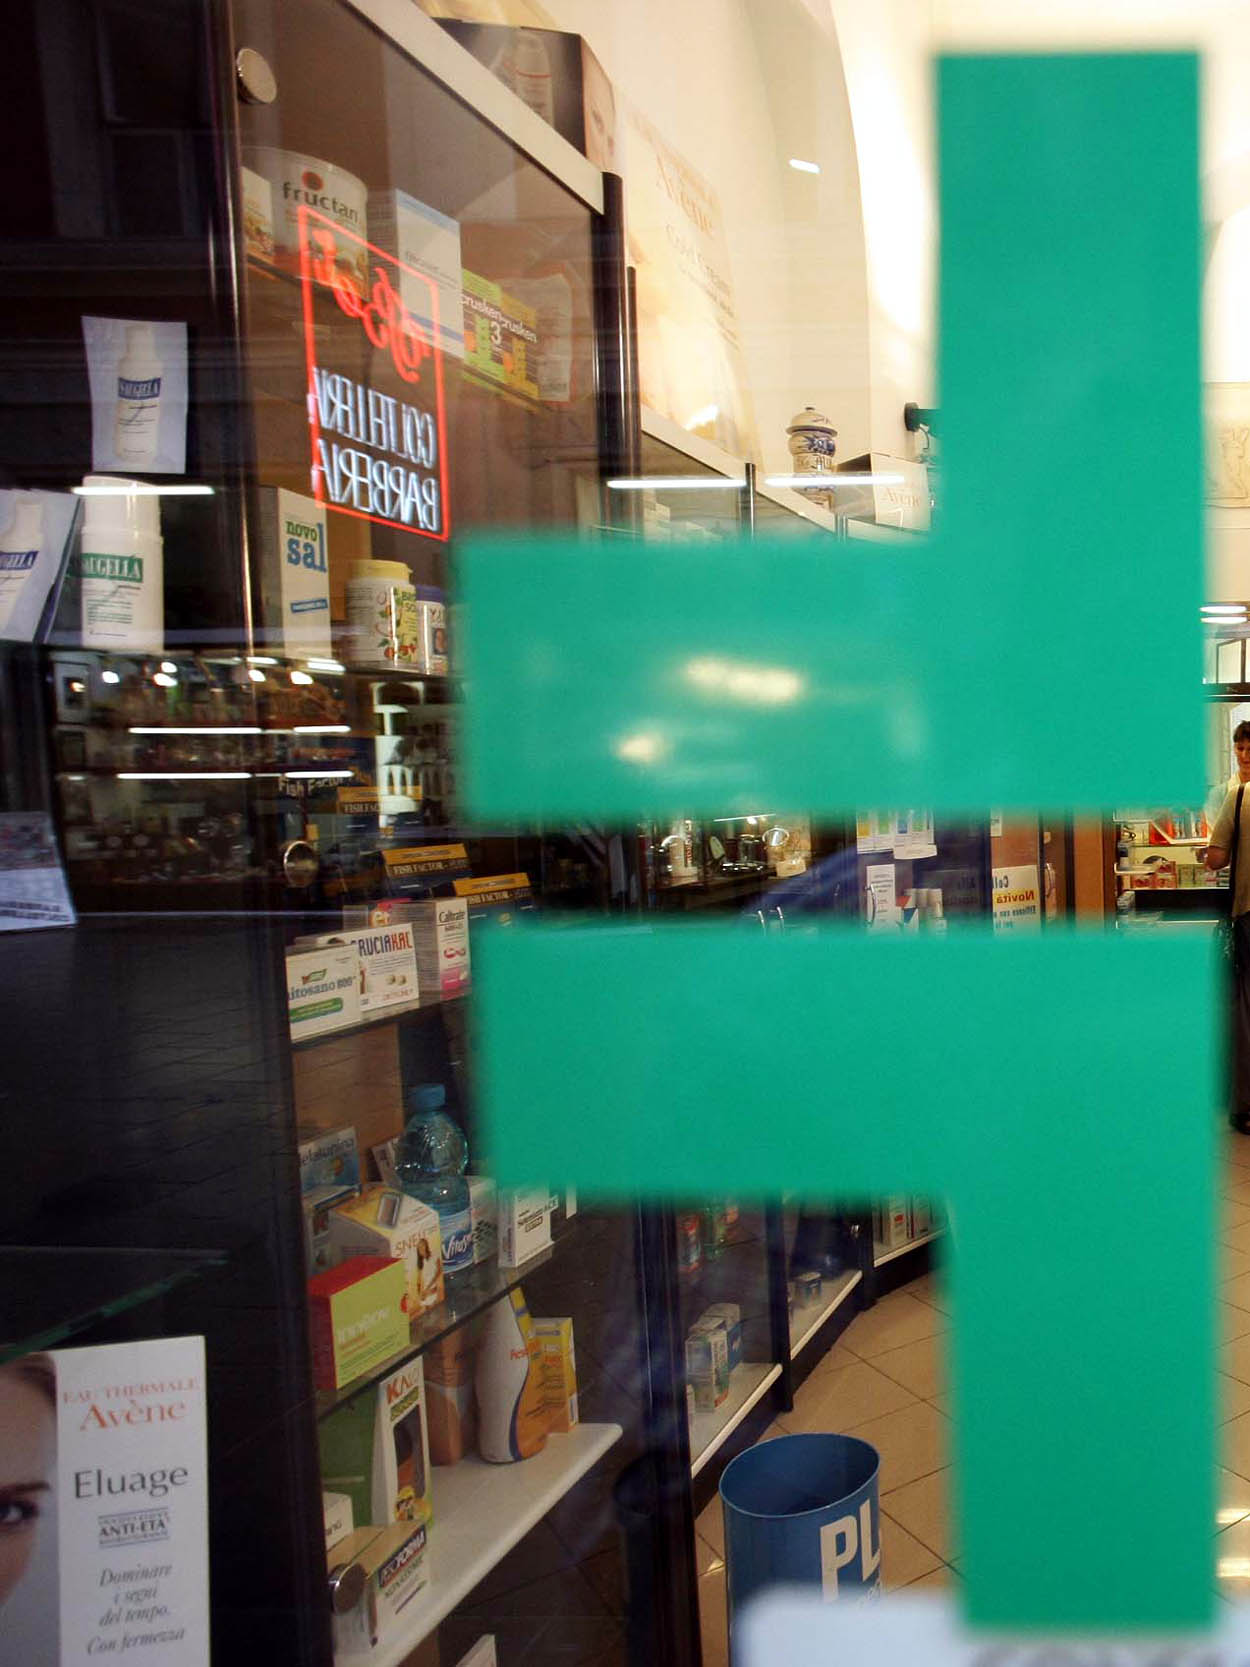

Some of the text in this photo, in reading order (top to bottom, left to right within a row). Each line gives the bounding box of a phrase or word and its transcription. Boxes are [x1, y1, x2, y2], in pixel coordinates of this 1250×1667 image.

[282, 180, 359, 223] fructan
[285, 521, 318, 542] novo
[286, 523, 327, 573] sal
[104, 1376, 200, 1400] THERMALE
[79, 1398, 188, 1432] Avène
[73, 1465, 189, 1500] Eluage
[99, 1562, 174, 1588] Dominare
[123, 1587, 159, 1606] segni
[99, 1609, 122, 1628] del
[86, 1625, 186, 1657] Con fermezza
